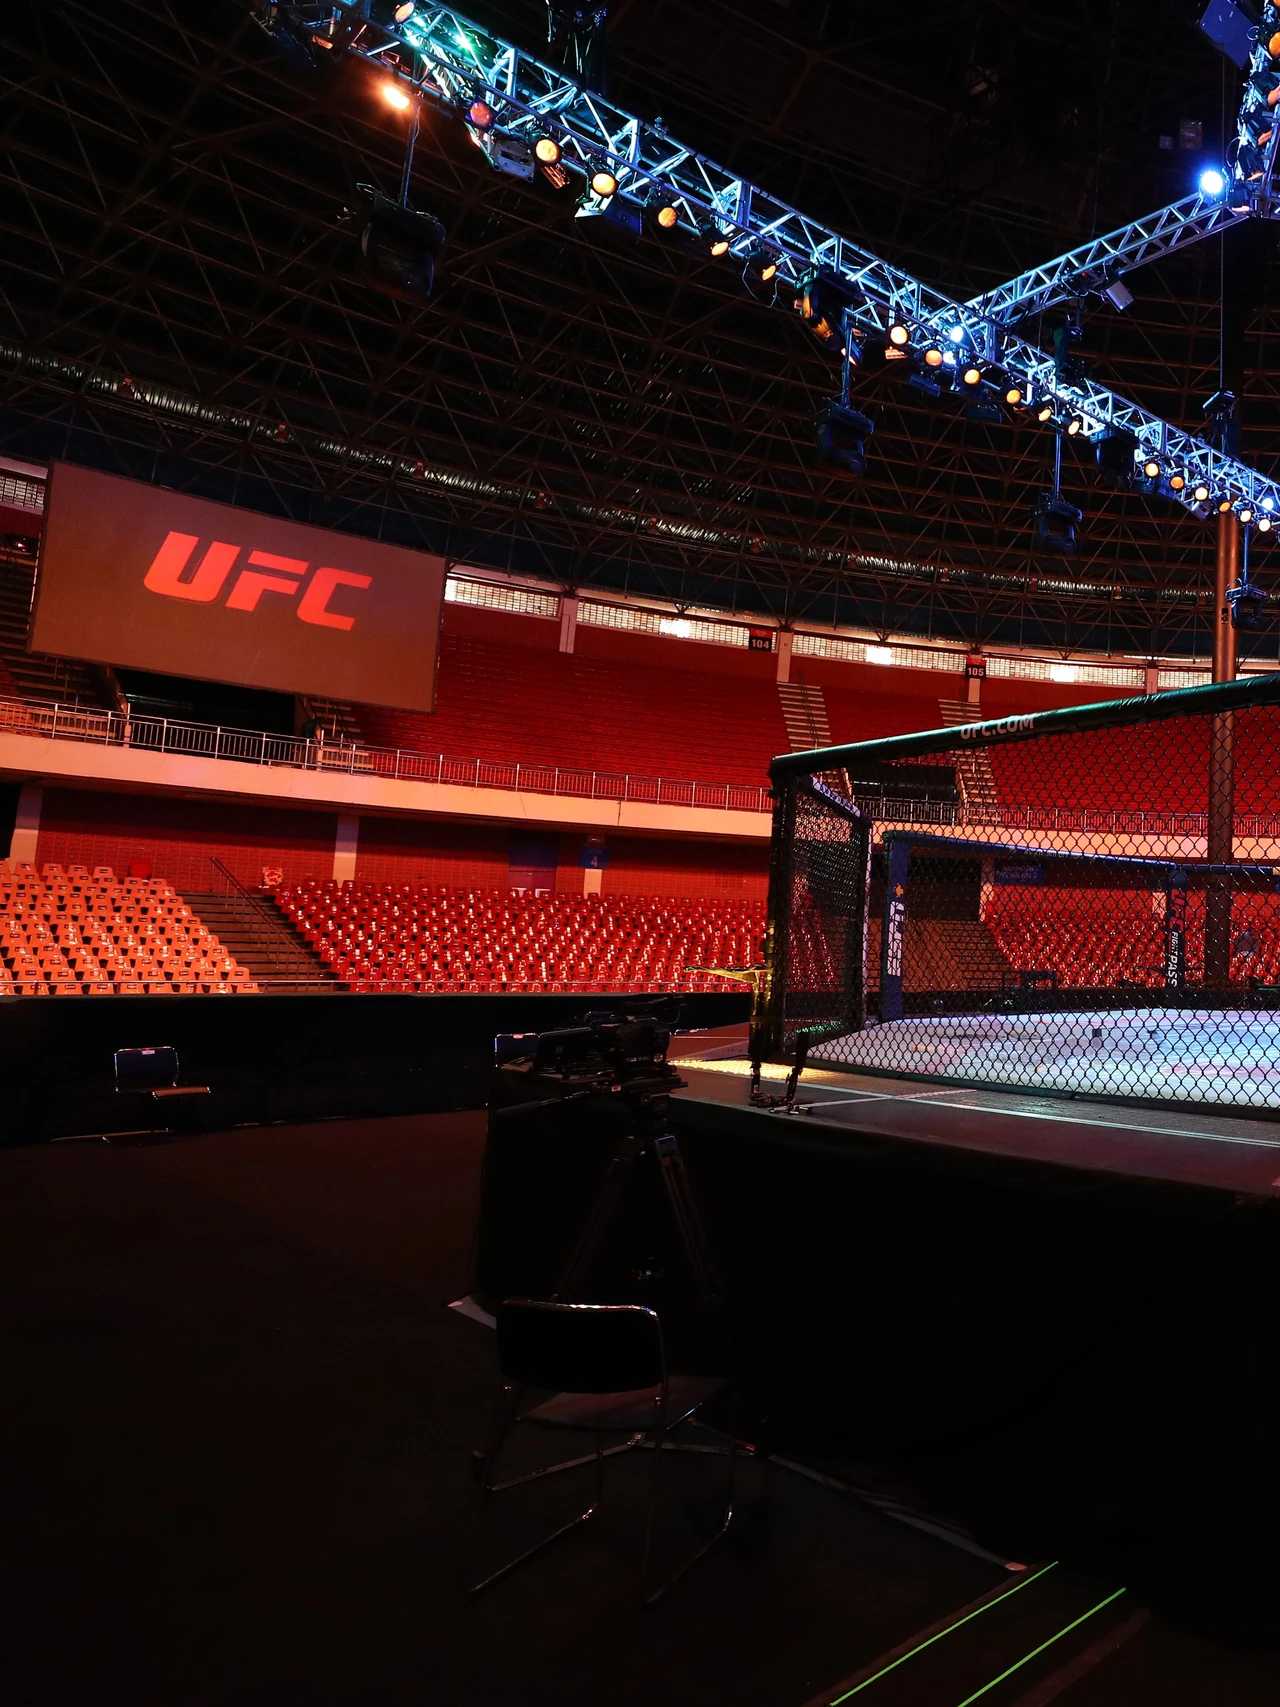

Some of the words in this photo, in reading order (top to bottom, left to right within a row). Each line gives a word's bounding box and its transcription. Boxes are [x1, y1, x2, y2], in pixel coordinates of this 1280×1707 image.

[143, 530, 373, 631] UFC
[751, 639, 770, 649] 104
[967, 667, 984, 677] 105
[960, 716, 1035, 740] UFC.COM
[590, 855, 598, 867] 4
[1169, 888, 1186, 931] UFC
